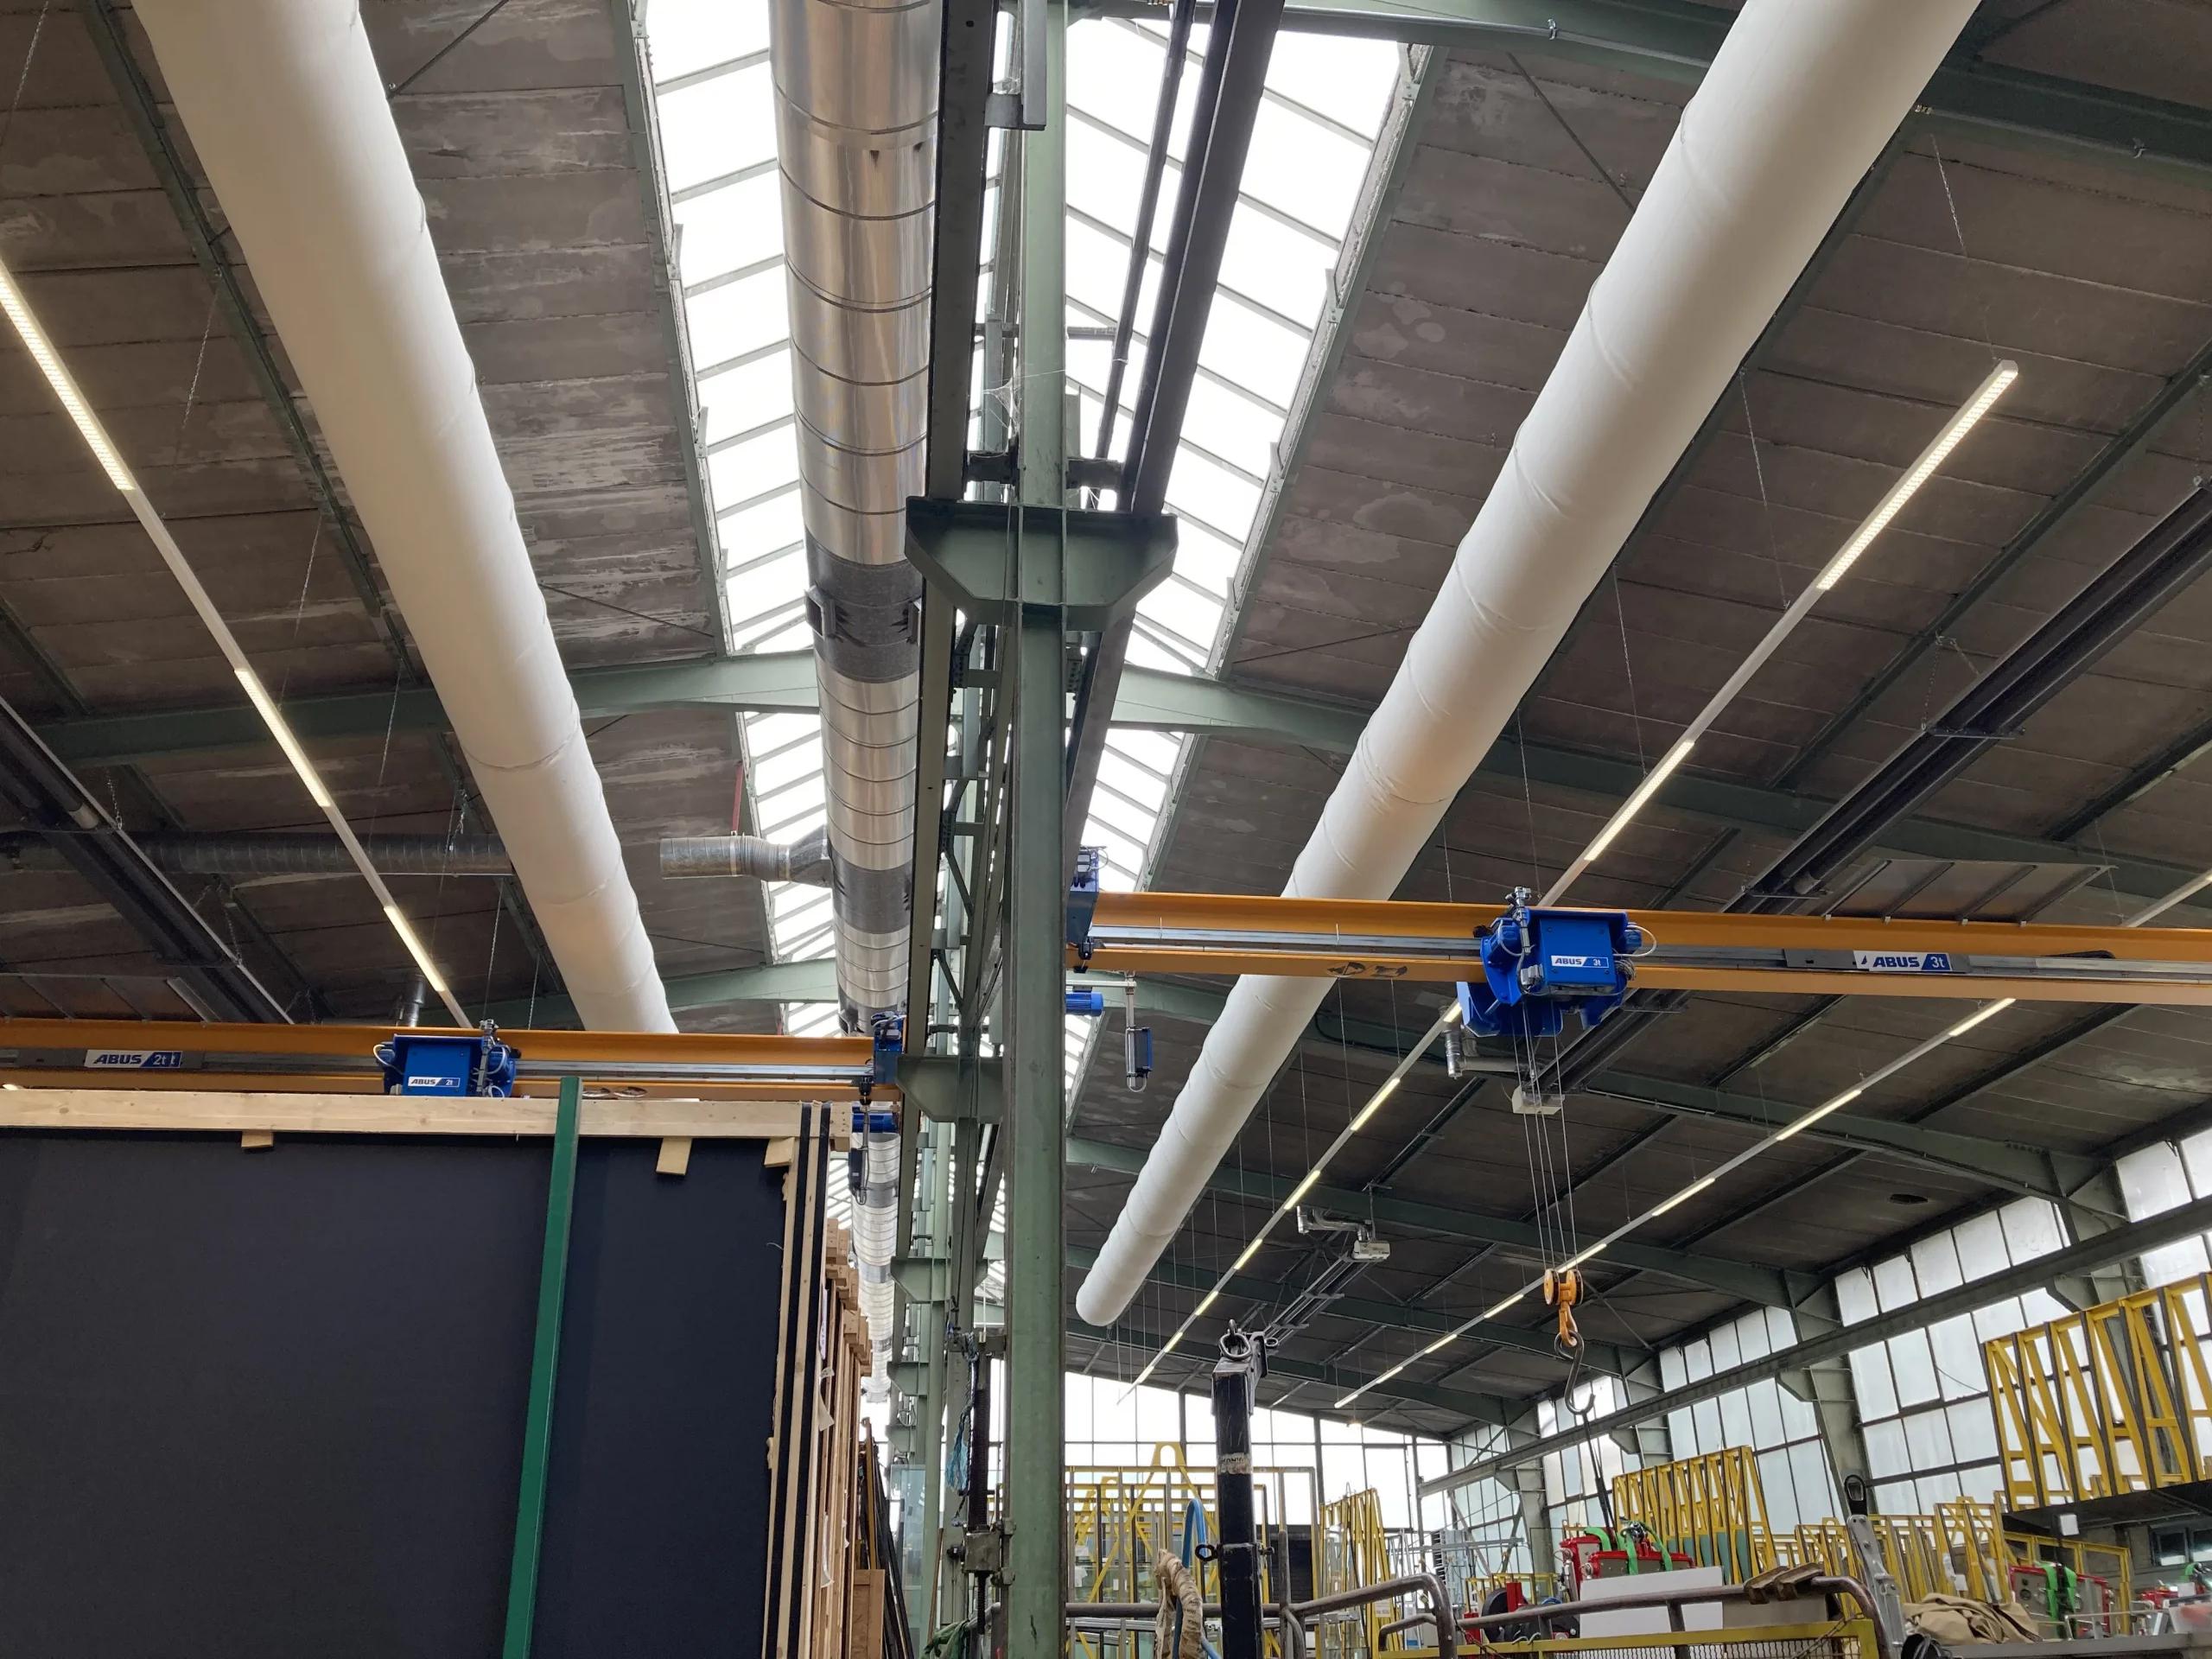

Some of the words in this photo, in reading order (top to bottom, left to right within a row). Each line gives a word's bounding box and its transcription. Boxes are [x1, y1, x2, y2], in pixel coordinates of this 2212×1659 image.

[1872, 957, 1920, 968] ABUS
[1930, 956, 1945, 968] 3t
[92, 1054, 143, 1065] ABUS
